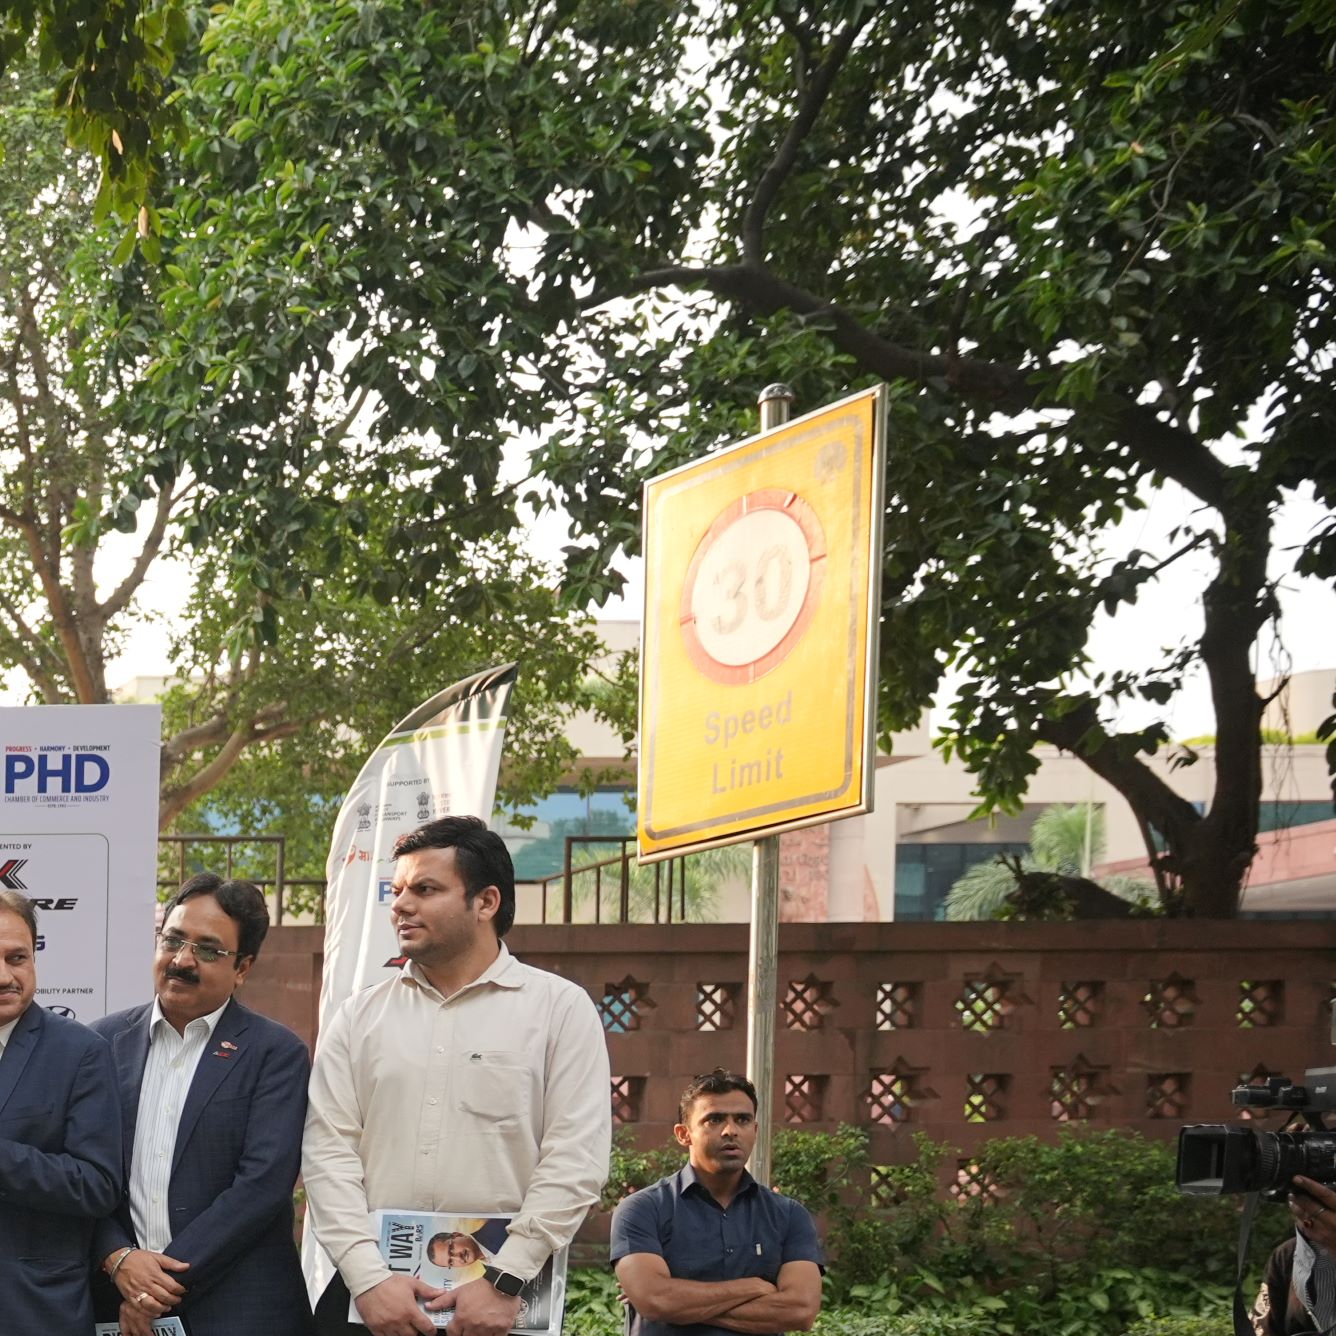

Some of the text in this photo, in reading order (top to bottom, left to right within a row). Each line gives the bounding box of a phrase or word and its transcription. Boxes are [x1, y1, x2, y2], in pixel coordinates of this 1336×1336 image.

[711, 544, 794, 636] 30
[703, 690, 792, 751] Speed
[5, 754, 111, 794] PHD
[711, 749, 785, 795] Limit
